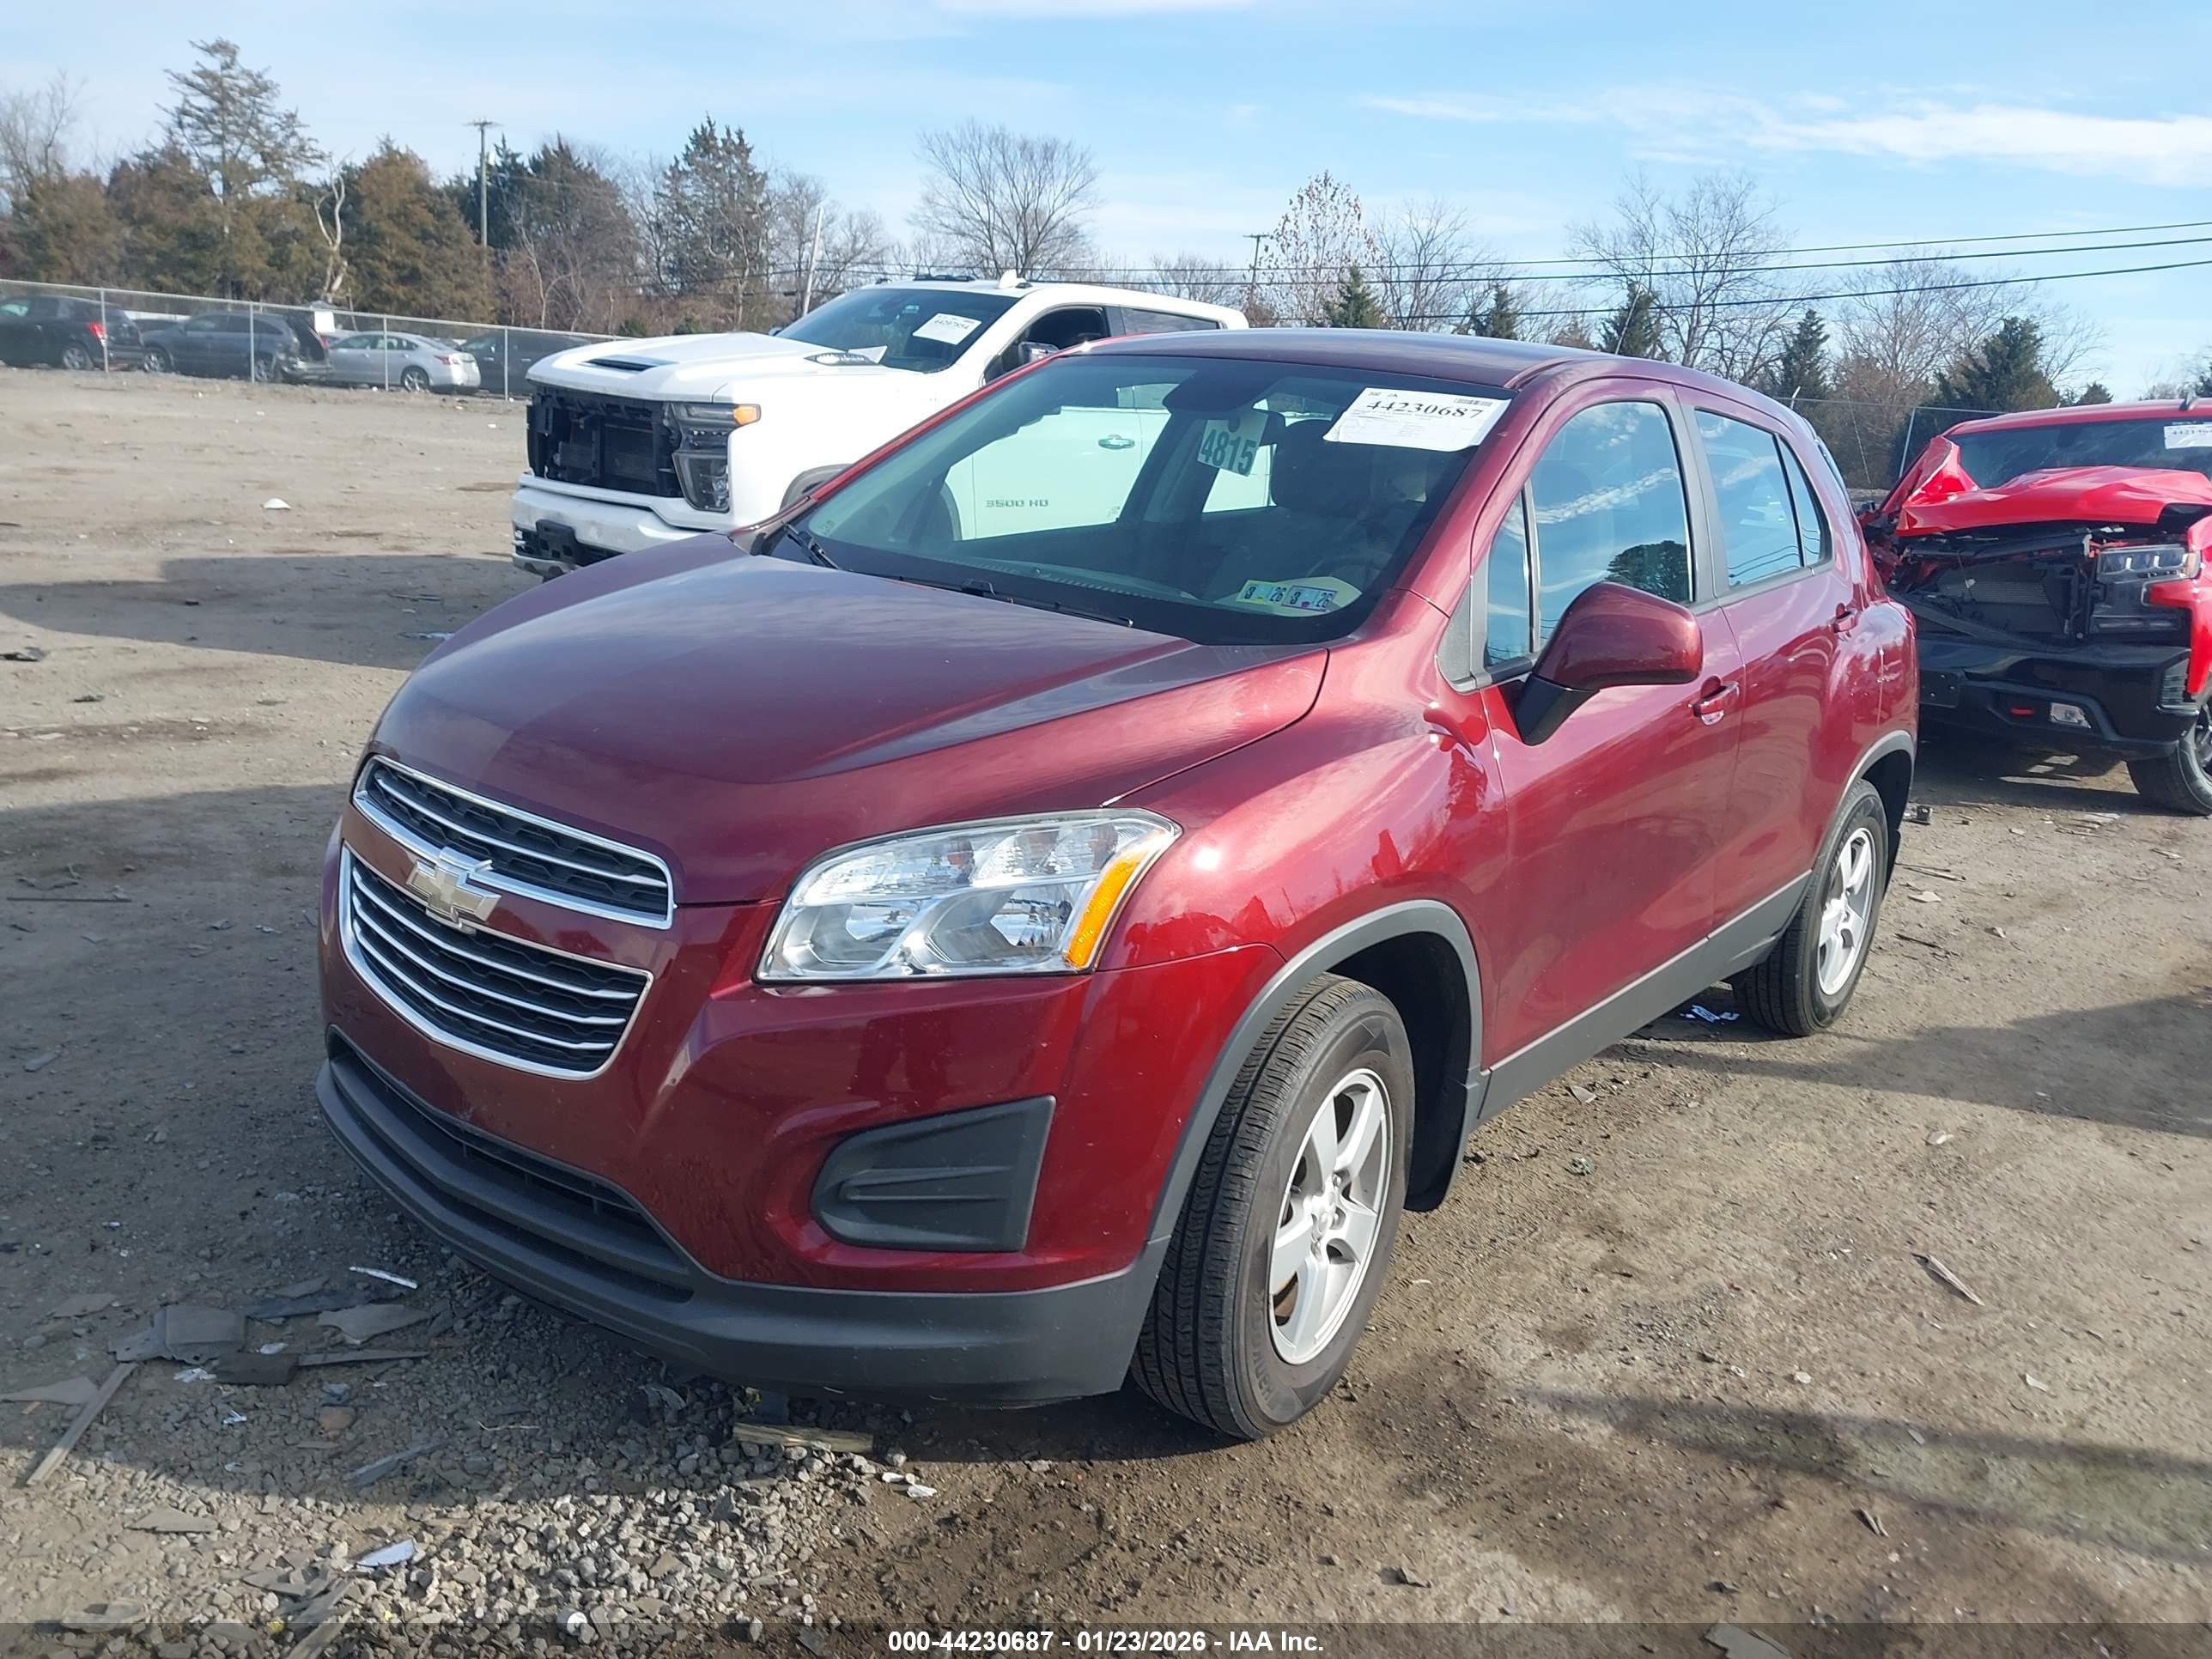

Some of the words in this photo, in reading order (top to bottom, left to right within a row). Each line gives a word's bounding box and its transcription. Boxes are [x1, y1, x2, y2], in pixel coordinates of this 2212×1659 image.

[1366, 400, 1485, 419] 44230687
[1200, 428, 1258, 476] 4815
[986, 499, 1025, 508] 3500
[1029, 499, 1049, 507] HD
[1243, 586, 1257, 599] 3
[1268, 586, 1287, 603] 26
[1289, 591, 1302, 605] 3
[1315, 592, 1334, 608] 26
